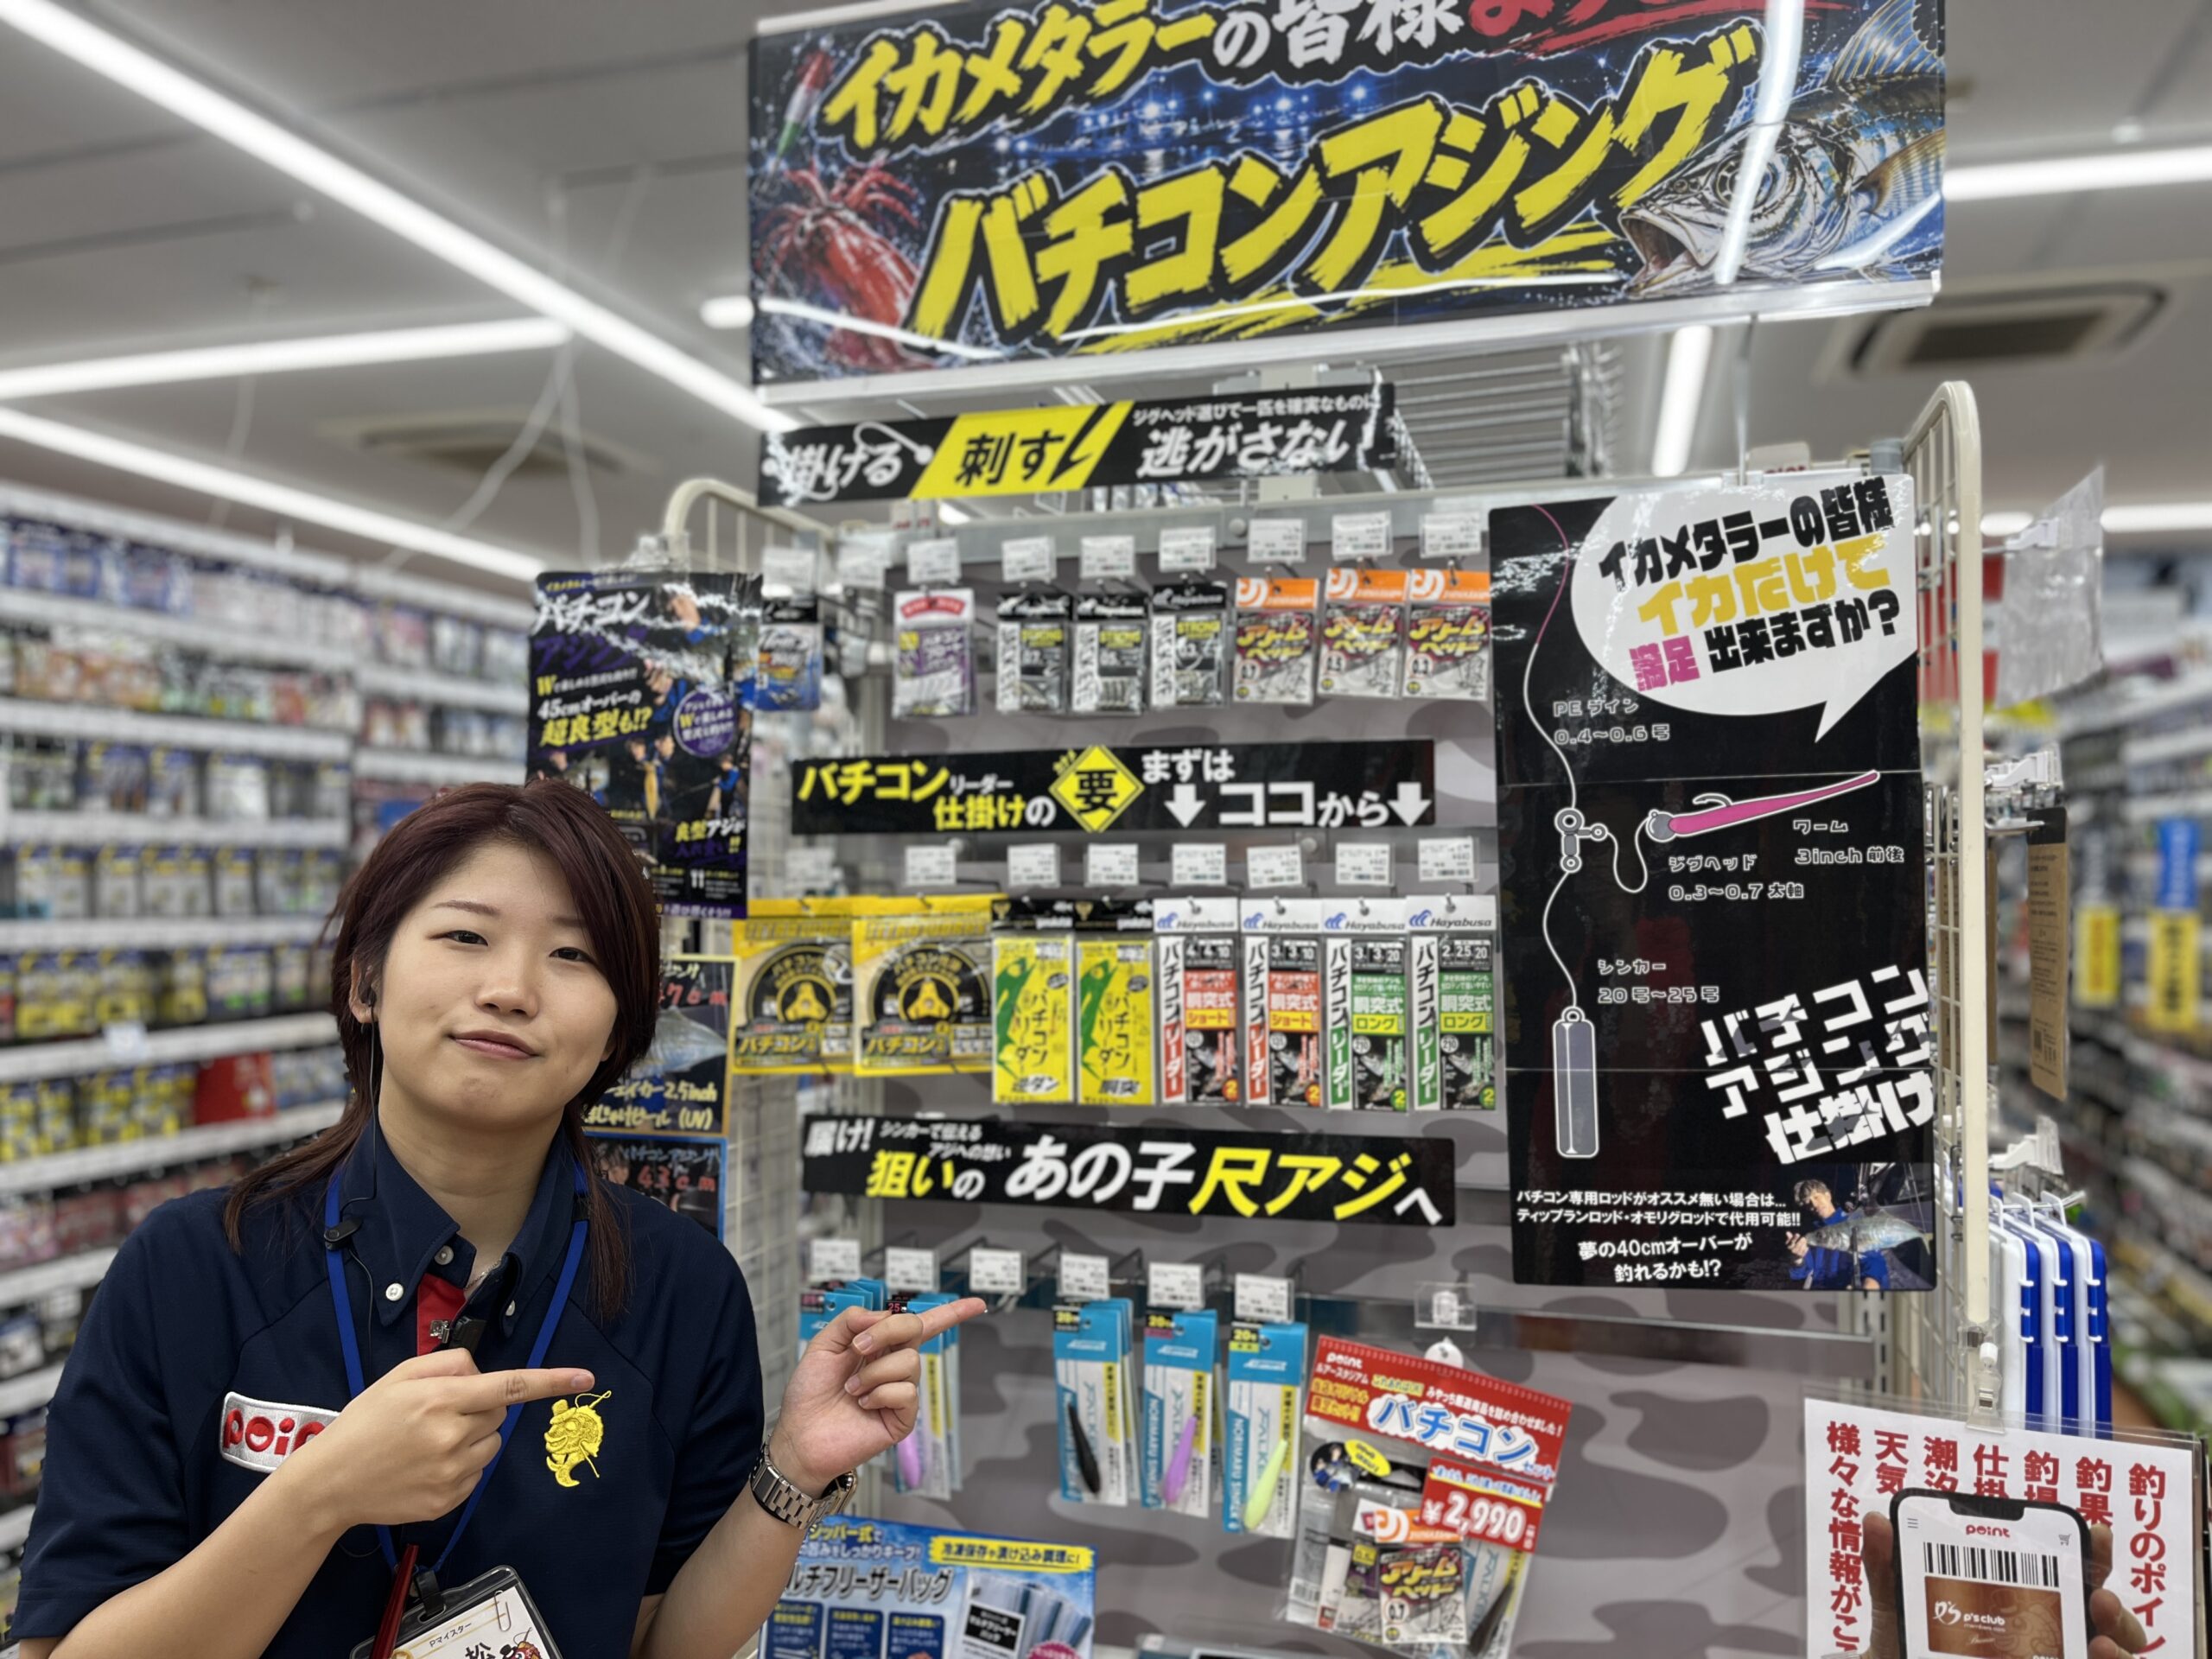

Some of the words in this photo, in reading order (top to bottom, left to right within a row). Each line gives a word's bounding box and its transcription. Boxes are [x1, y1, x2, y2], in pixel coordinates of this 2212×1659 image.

[908, 24, 1758, 340] バチコンアジング
[956, 429, 1067, 486] 刺す
[1599, 476, 1895, 593] イカメタラーの皆様
[1629, 635, 1700, 691] 満足
[1704, 588, 1901, 674] 出来ますか?
[1554, 701, 1583, 718] PE
[1586, 698, 1639, 717] ライン
[1651, 724, 1670, 741] 号
[1141, 748, 1235, 783] まずは
[798, 760, 950, 802] バチコン
[950, 773, 1014, 796] リーダー
[1074, 769, 1119, 815] 要
[932, 793, 1057, 831] 仕掛けの
[1219, 782, 1389, 827] ココから
[1793, 818, 1849, 835] ワーム
[1668, 854, 1758, 873] ジグヘッド
[1795, 848, 1863, 866] 3inch
[1866, 846, 1905, 863] 前後
[1768, 882, 1805, 900] 太軸
[1431, 917, 1493, 930] Hayabusa
[1598, 958, 1668, 976] シンカー
[1598, 987, 1628, 1003] 20
[1700, 985, 1720, 1002] 号
[1355, 1017, 1395, 1031] ロング
[1443, 1015, 1484, 1029] ロング
[1700, 964, 1929, 1066] バチコン
[1764, 1070, 1935, 1164] 仕掛け
[1577, 1232, 1753, 1262] 夢の40cmオーバーが
[1614, 1259, 1722, 1282] 釣れるかも!?
[1326, 1352, 1363, 1370] point
[1374, 1396, 1536, 1466] バチコン
[1874, 1430, 1910, 1496] 天気
[2075, 1457, 2113, 1529] 釣果
[1422, 1491, 1527, 1544] ¥2,990
[1965, 1523, 2011, 1539] point
[2128, 1464, 2167, 1659] 釣りのポイン
[429, 1622, 473, 1649] Pマイスター
